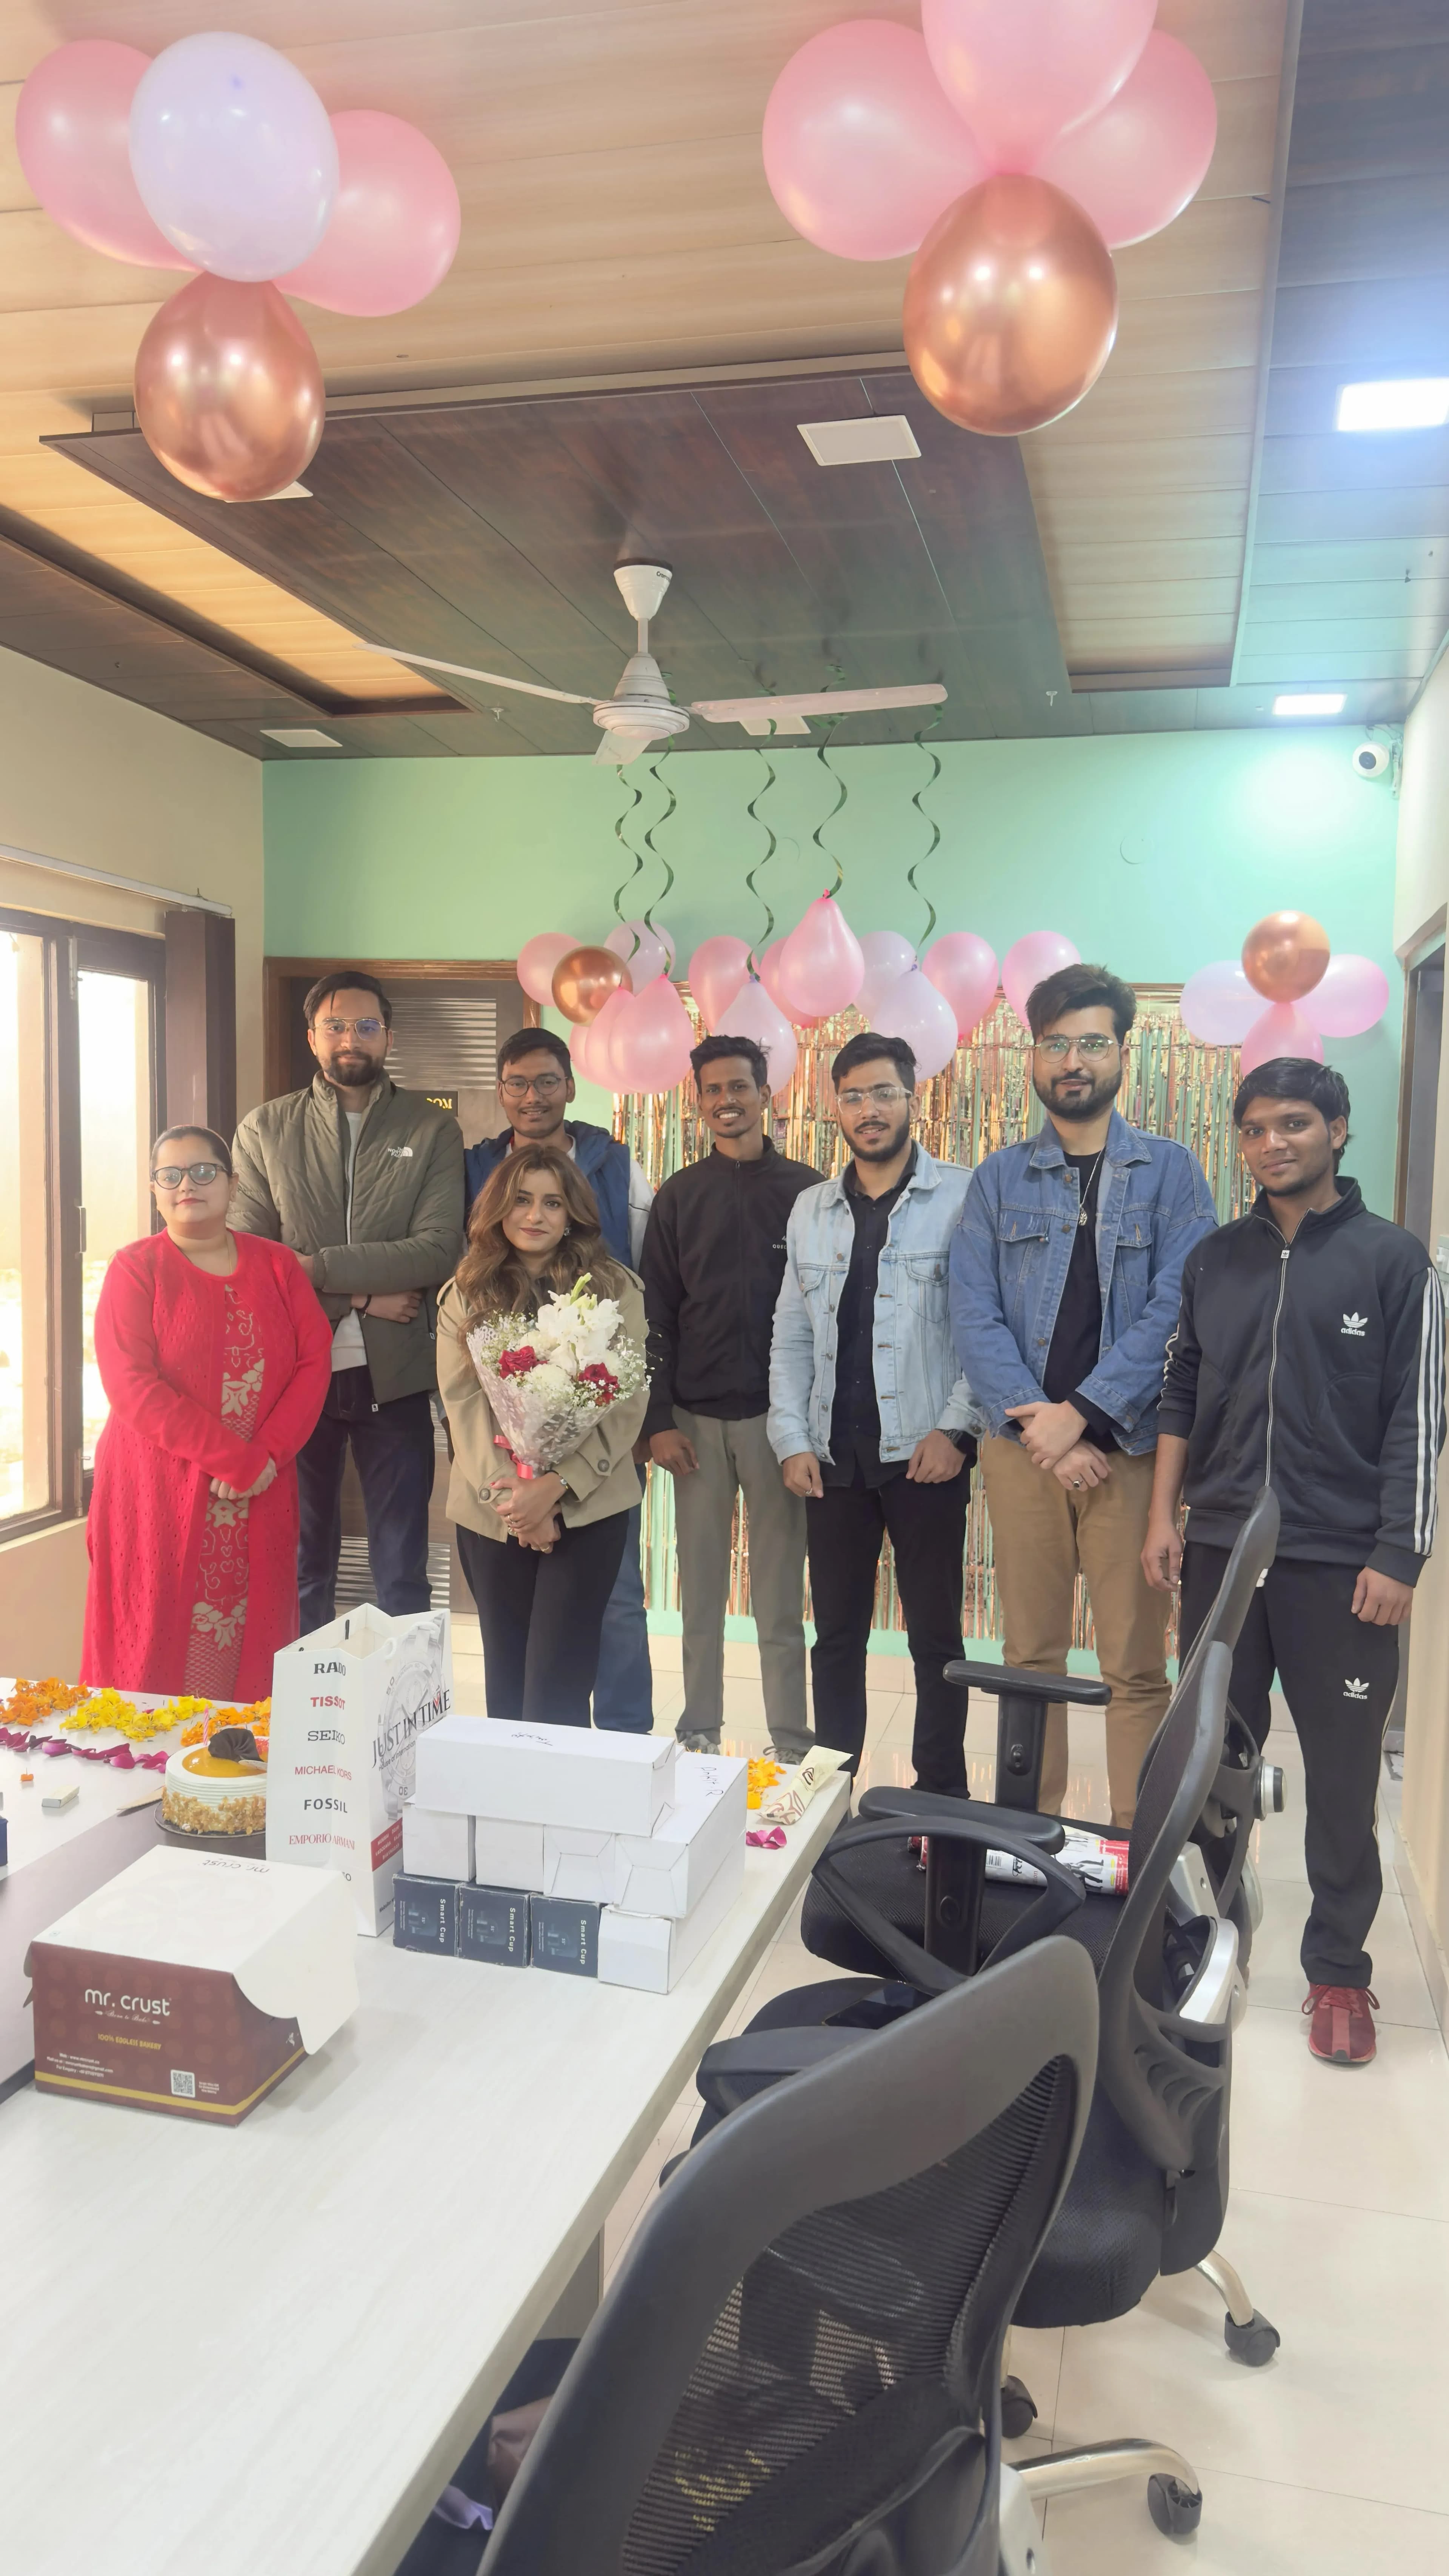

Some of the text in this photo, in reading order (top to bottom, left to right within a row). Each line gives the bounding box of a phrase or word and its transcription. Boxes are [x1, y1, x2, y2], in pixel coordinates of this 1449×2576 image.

[1341, 1327, 1365, 1336] adidas
[314, 1662, 346, 1676] RADO
[1343, 1691, 1367, 1699] adidas
[310, 1696, 345, 1710] TISSOT
[372, 1722, 401, 1769] JUST
[403, 1711, 417, 1740] IN
[419, 1689, 451, 1727] TIME
[308, 1730, 345, 1745] SEIKO
[378, 1759, 391, 1771] House
[391, 1754, 395, 1762] of
[395, 1740, 416, 1759] Internation
[295, 1765, 352, 1780] MICHAEL KORS
[304, 1798, 348, 1813] FOSSIL
[289, 1833, 355, 1850] EMPORIO ARMANI
[202, 1859, 241, 1869] crust
[246, 1865, 270, 1873] mr.
[85, 1989, 170, 2016] mr. crust
[97, 2033, 115, 2042] 100%
[139, 2041, 162, 2050] BAKERY
